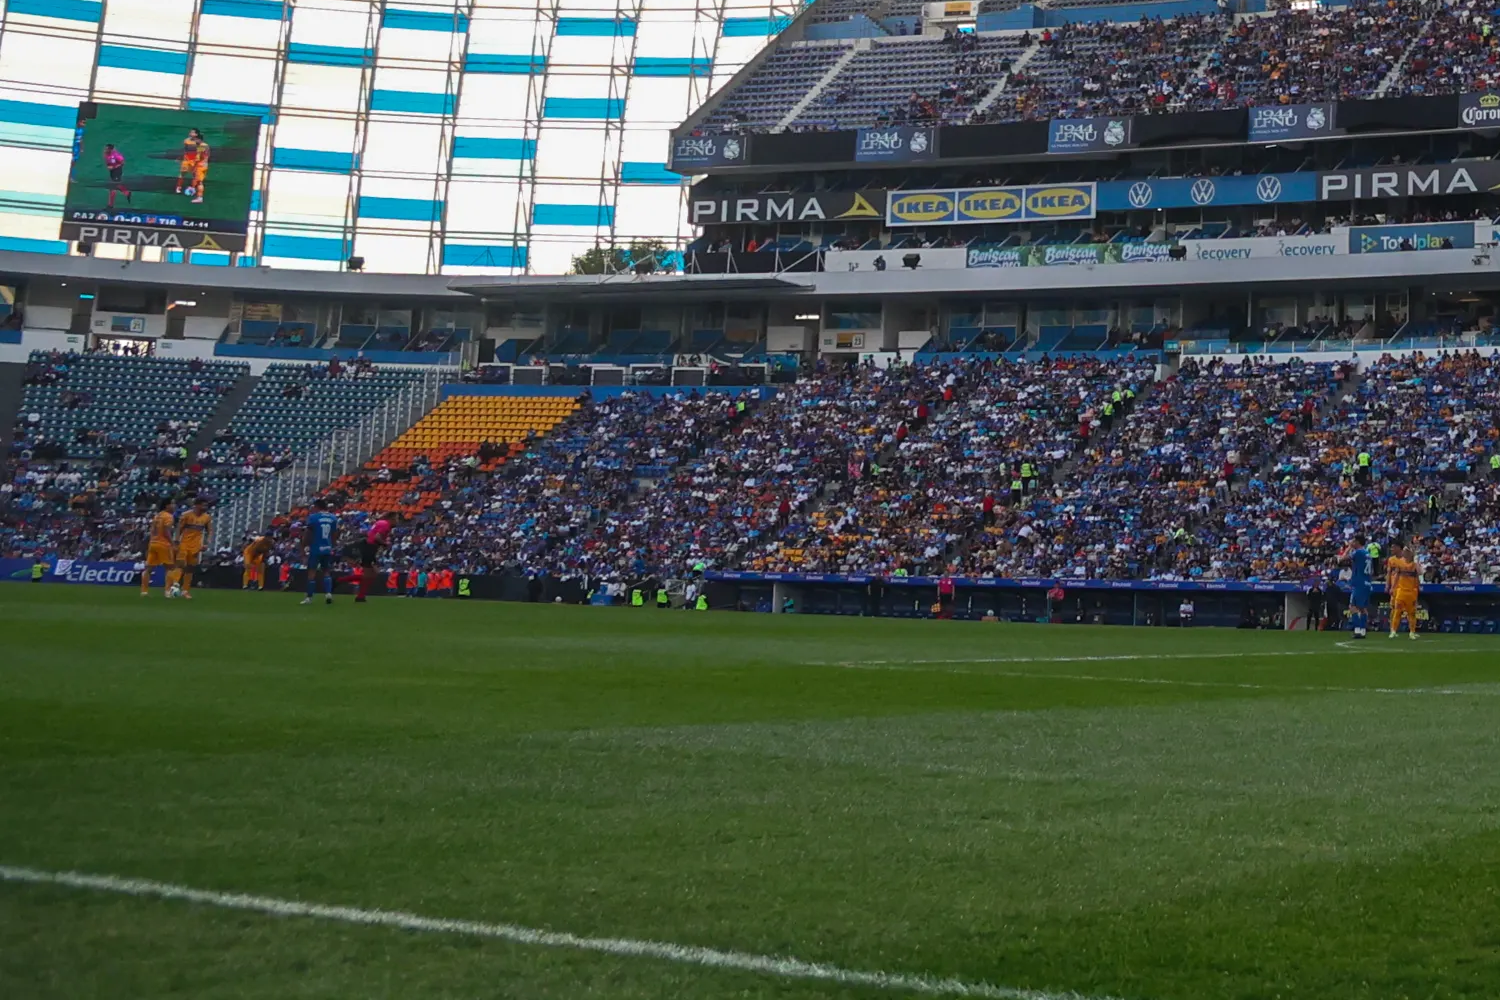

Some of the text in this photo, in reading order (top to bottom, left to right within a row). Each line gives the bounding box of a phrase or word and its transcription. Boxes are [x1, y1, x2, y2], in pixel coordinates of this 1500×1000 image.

[1258, 108, 1293, 119] 1944
[1253, 115, 1298, 128] LFNU
[1060, 124, 1093, 134] 1944
[865, 132, 898, 141] 1944
[1055, 131, 1097, 142] LFNU
[681, 139, 713, 149] 1944
[861, 138, 902, 150] LFNU
[677, 146, 716, 156] LFNU
[1322, 168, 1478, 200] PIRMA
[897, 200, 951, 215] IKEA
[964, 197, 1017, 212] IKEA
[1032, 194, 1084, 209] IKEA
[693, 197, 826, 223] PIRMA
[79, 227, 182, 247] PIRMA
